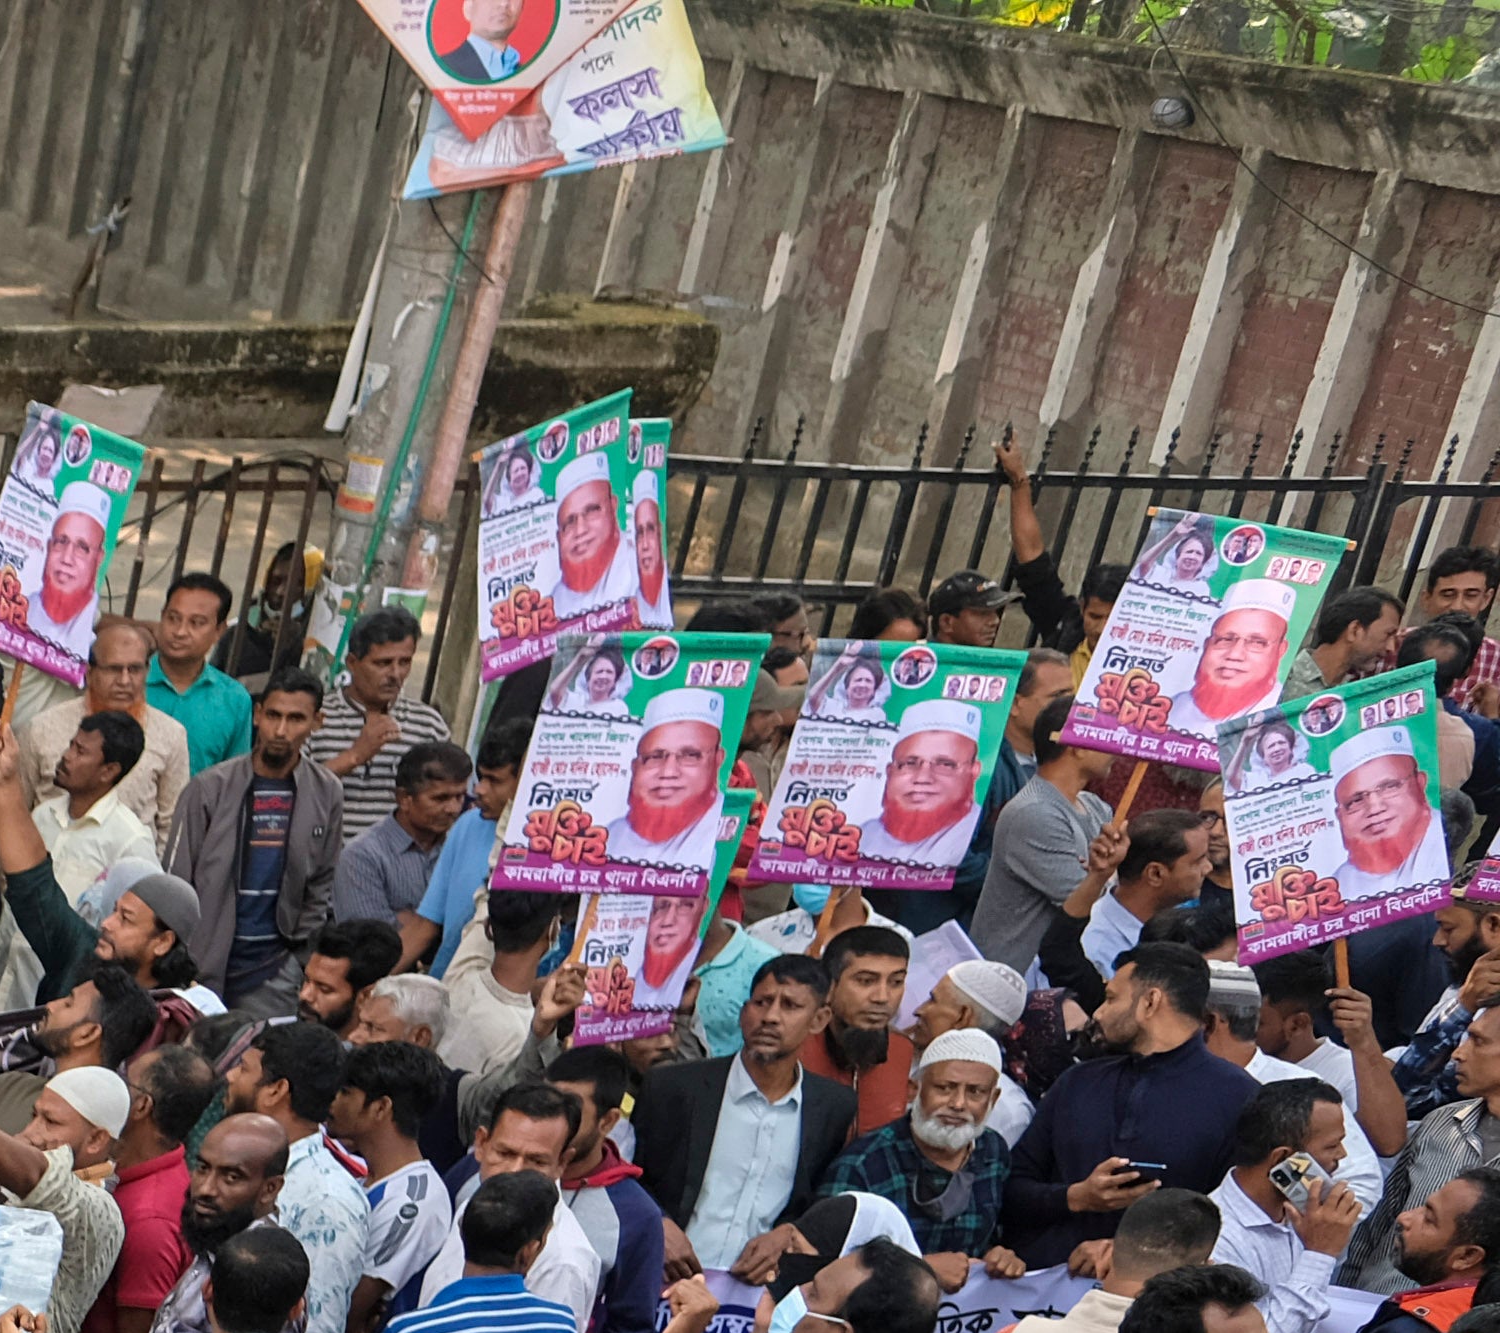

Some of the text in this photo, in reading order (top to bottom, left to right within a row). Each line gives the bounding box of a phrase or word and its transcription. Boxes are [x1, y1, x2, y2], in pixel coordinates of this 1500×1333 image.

[581, 52, 614, 75] পদে
[567, 67, 663, 122] কলস
[488, 561, 539, 602] নিঃশর্ত
[491, 584, 541, 635] মুক্তি
[516, 595, 560, 639] চাই
[1102, 645, 1173, 673] নিঃশর্ত
[1094, 667, 1160, 716] মুক্তি
[1117, 694, 1173, 734] চাই
[1073, 720, 1193, 760] কামরাঙ্গীর চর থানা
[528, 781, 600, 807] নিঃশর্ত
[784, 780, 856, 805] নিঃশর্ত
[523, 799, 592, 851] মুক্তি
[777, 798, 847, 848] মুক্তি
[804, 824, 863, 862] চাই
[551, 824, 609, 865] চাই
[1245, 840, 1313, 885] নিঃশর্ত
[504, 863, 698, 889] কামরাঙ্গীর চর থানা বিএনপি
[759, 856, 948, 882] কামরাঙ্গীর চর থানা বিএনপি
[1250, 864, 1318, 922] মুক্তি
[1285, 875, 1347, 924] চাই
[1246, 922, 1319, 955] কামরাঙ্গীর
[1322, 916, 1345, 932] চর
[1348, 904, 1382, 927] থানা
[1385, 884, 1445, 916] বিএনপি
